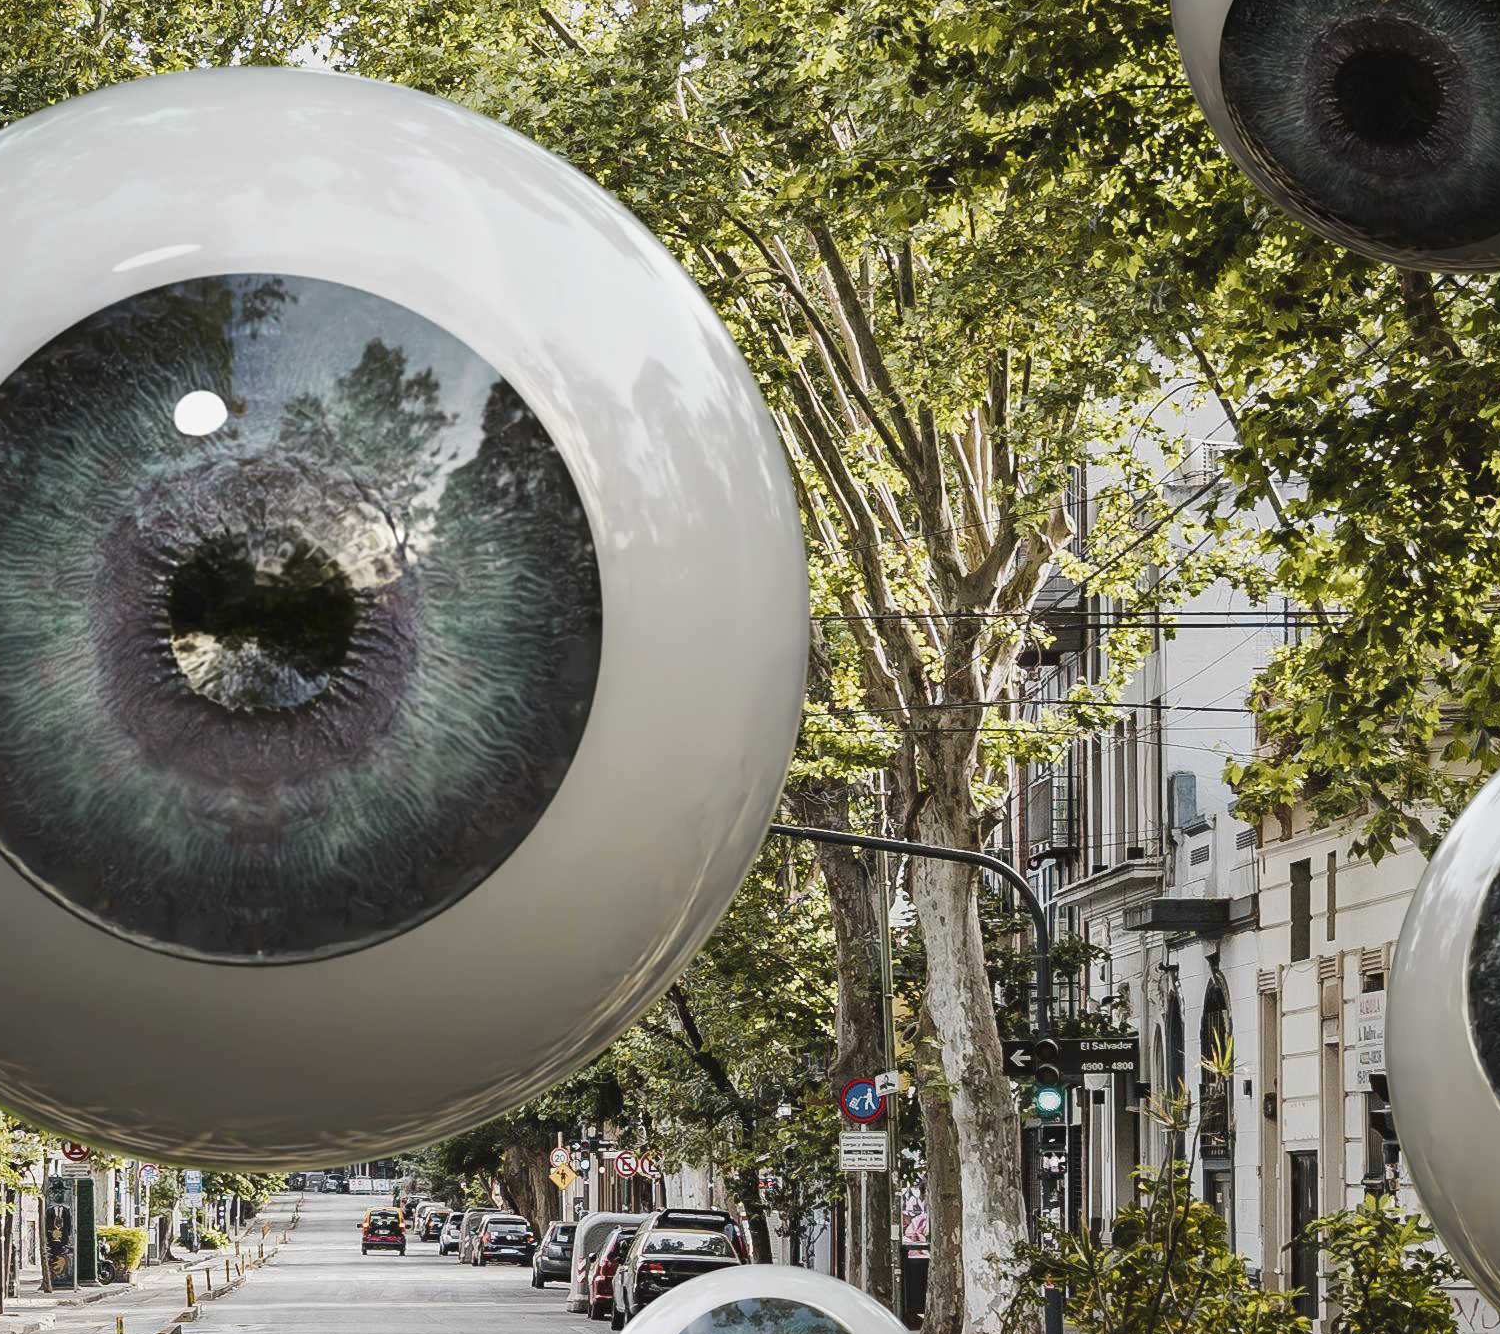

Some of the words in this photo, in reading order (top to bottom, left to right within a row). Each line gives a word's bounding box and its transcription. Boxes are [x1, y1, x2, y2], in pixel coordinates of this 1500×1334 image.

[1080, 1042, 1090, 1051] El
[1092, 1041, 1133, 1051] Salvador
[554, 1155, 566, 1163] 20
